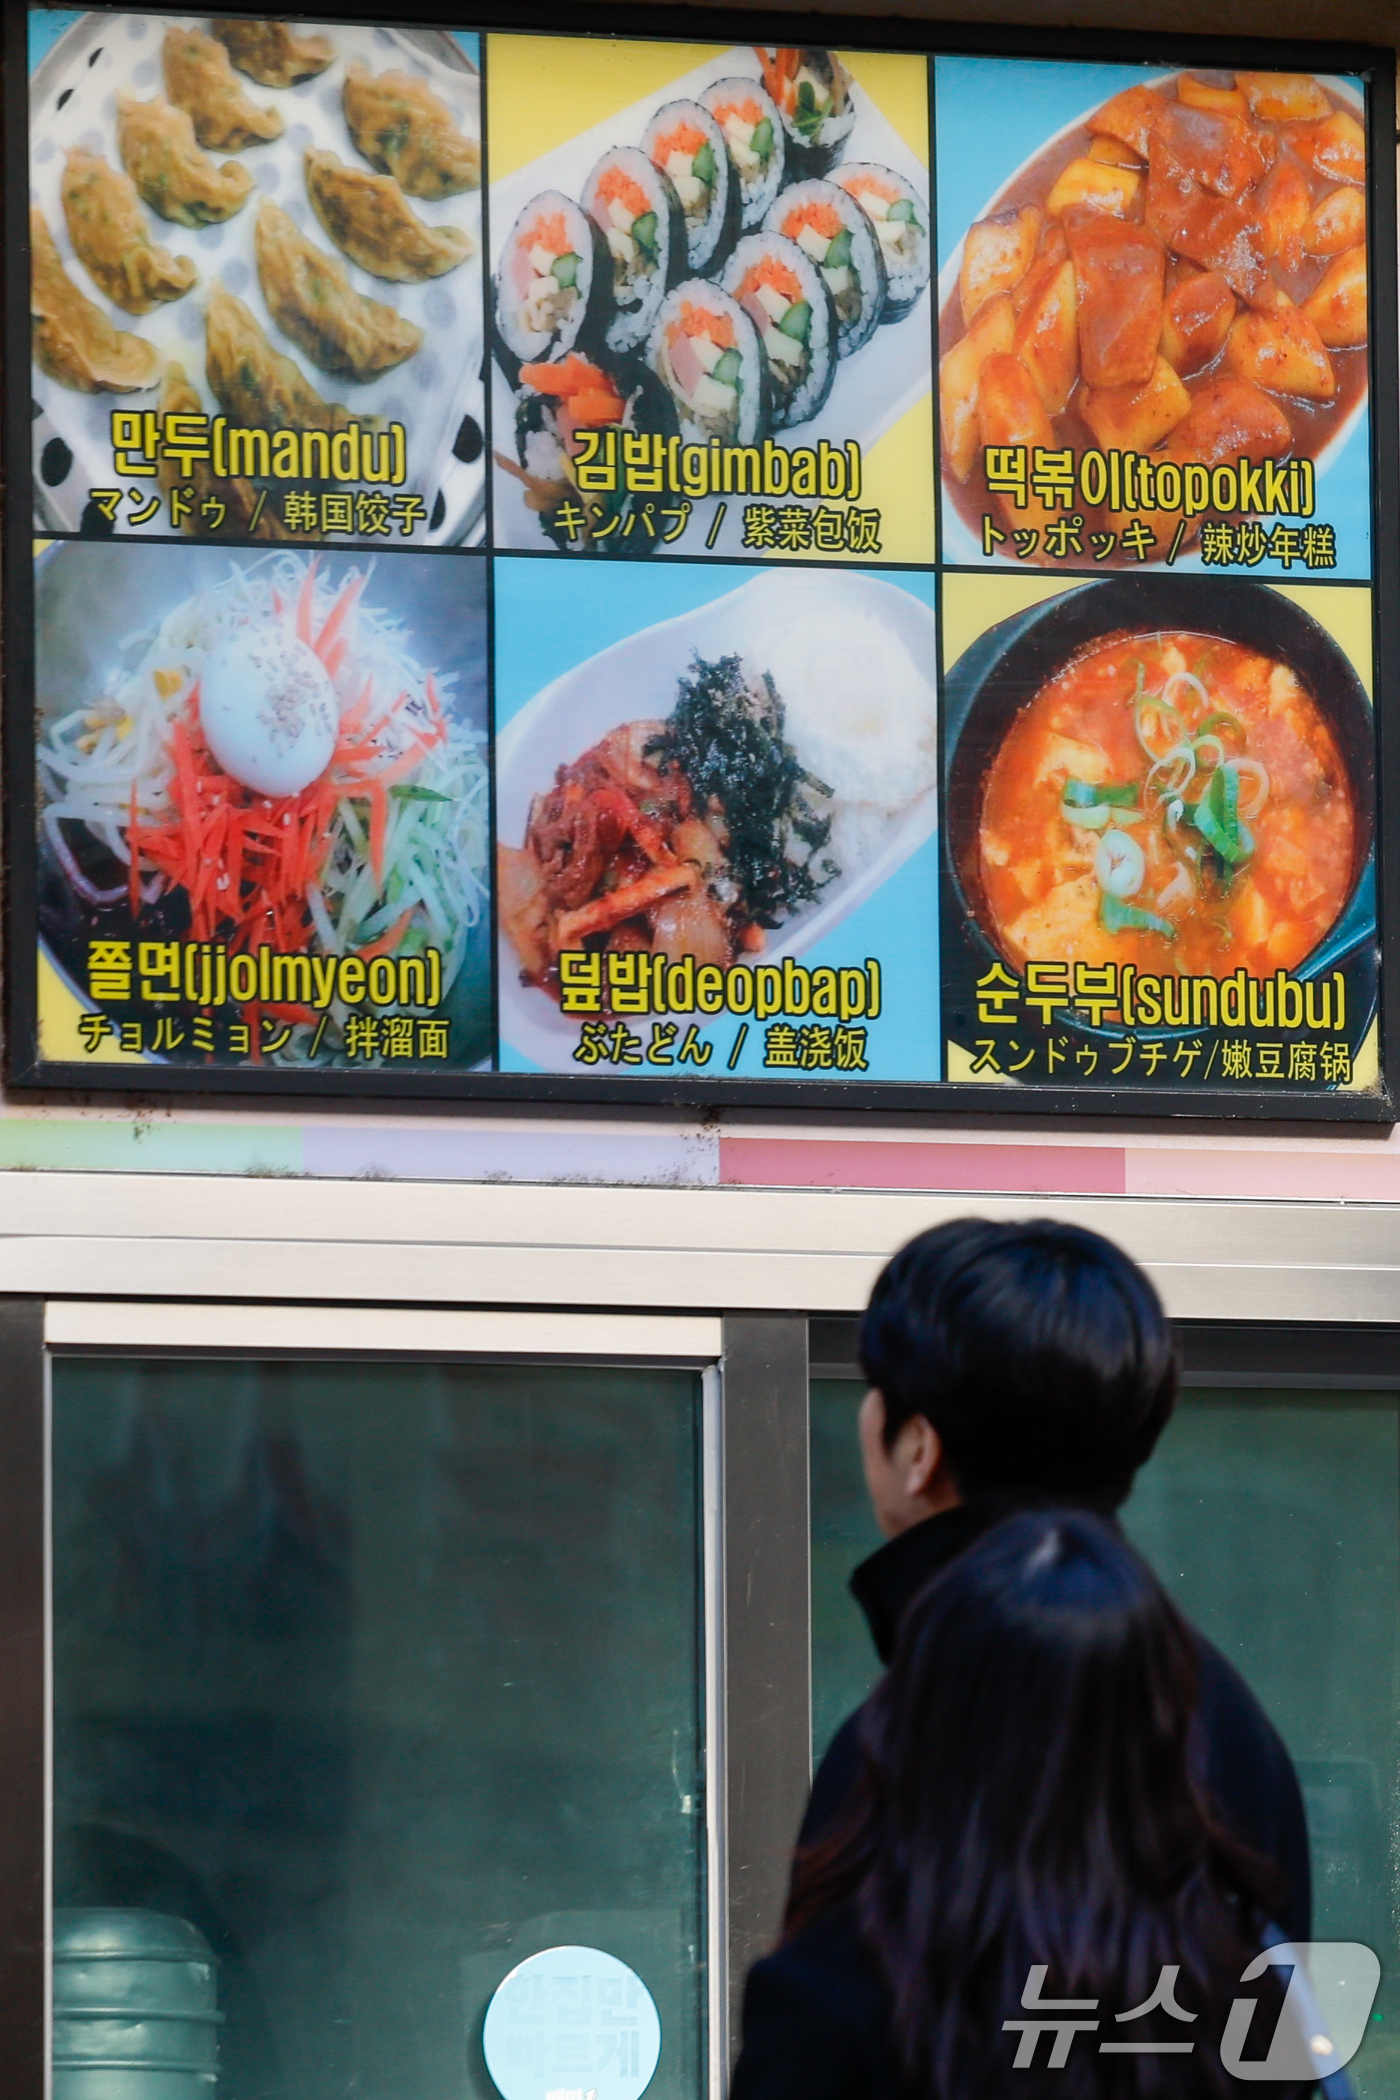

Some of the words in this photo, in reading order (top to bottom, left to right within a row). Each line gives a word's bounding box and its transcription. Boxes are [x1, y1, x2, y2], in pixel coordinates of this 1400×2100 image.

[111, 410, 406, 485] 만두(mandu)
[574, 431, 862, 500] 김밥(gimbab)
[90, 488, 227, 530] マンドゥ
[283, 491, 427, 535] 韩国饺子
[985, 447, 1314, 517] 떡볶이(topokki)
[554, 502, 691, 542] キンパプ
[744, 507, 881, 552] 紫菜包饭
[982, 515, 1156, 560] トッポッキ
[1203, 522, 1336, 568] 辣炒年糕
[87, 940, 442, 1008] 쫄면(jjolmyeon)
[559, 952, 882, 1020] 덮밥(deopbap)
[975, 962, 1346, 1030] 순두부(sundubu)
[79, 1013, 291, 1054] チョルミョン
[345, 1016, 450, 1059] 拌溜面
[574, 1023, 711, 1066] ぶたどん
[765, 1026, 868, 1070] 盖浇饭
